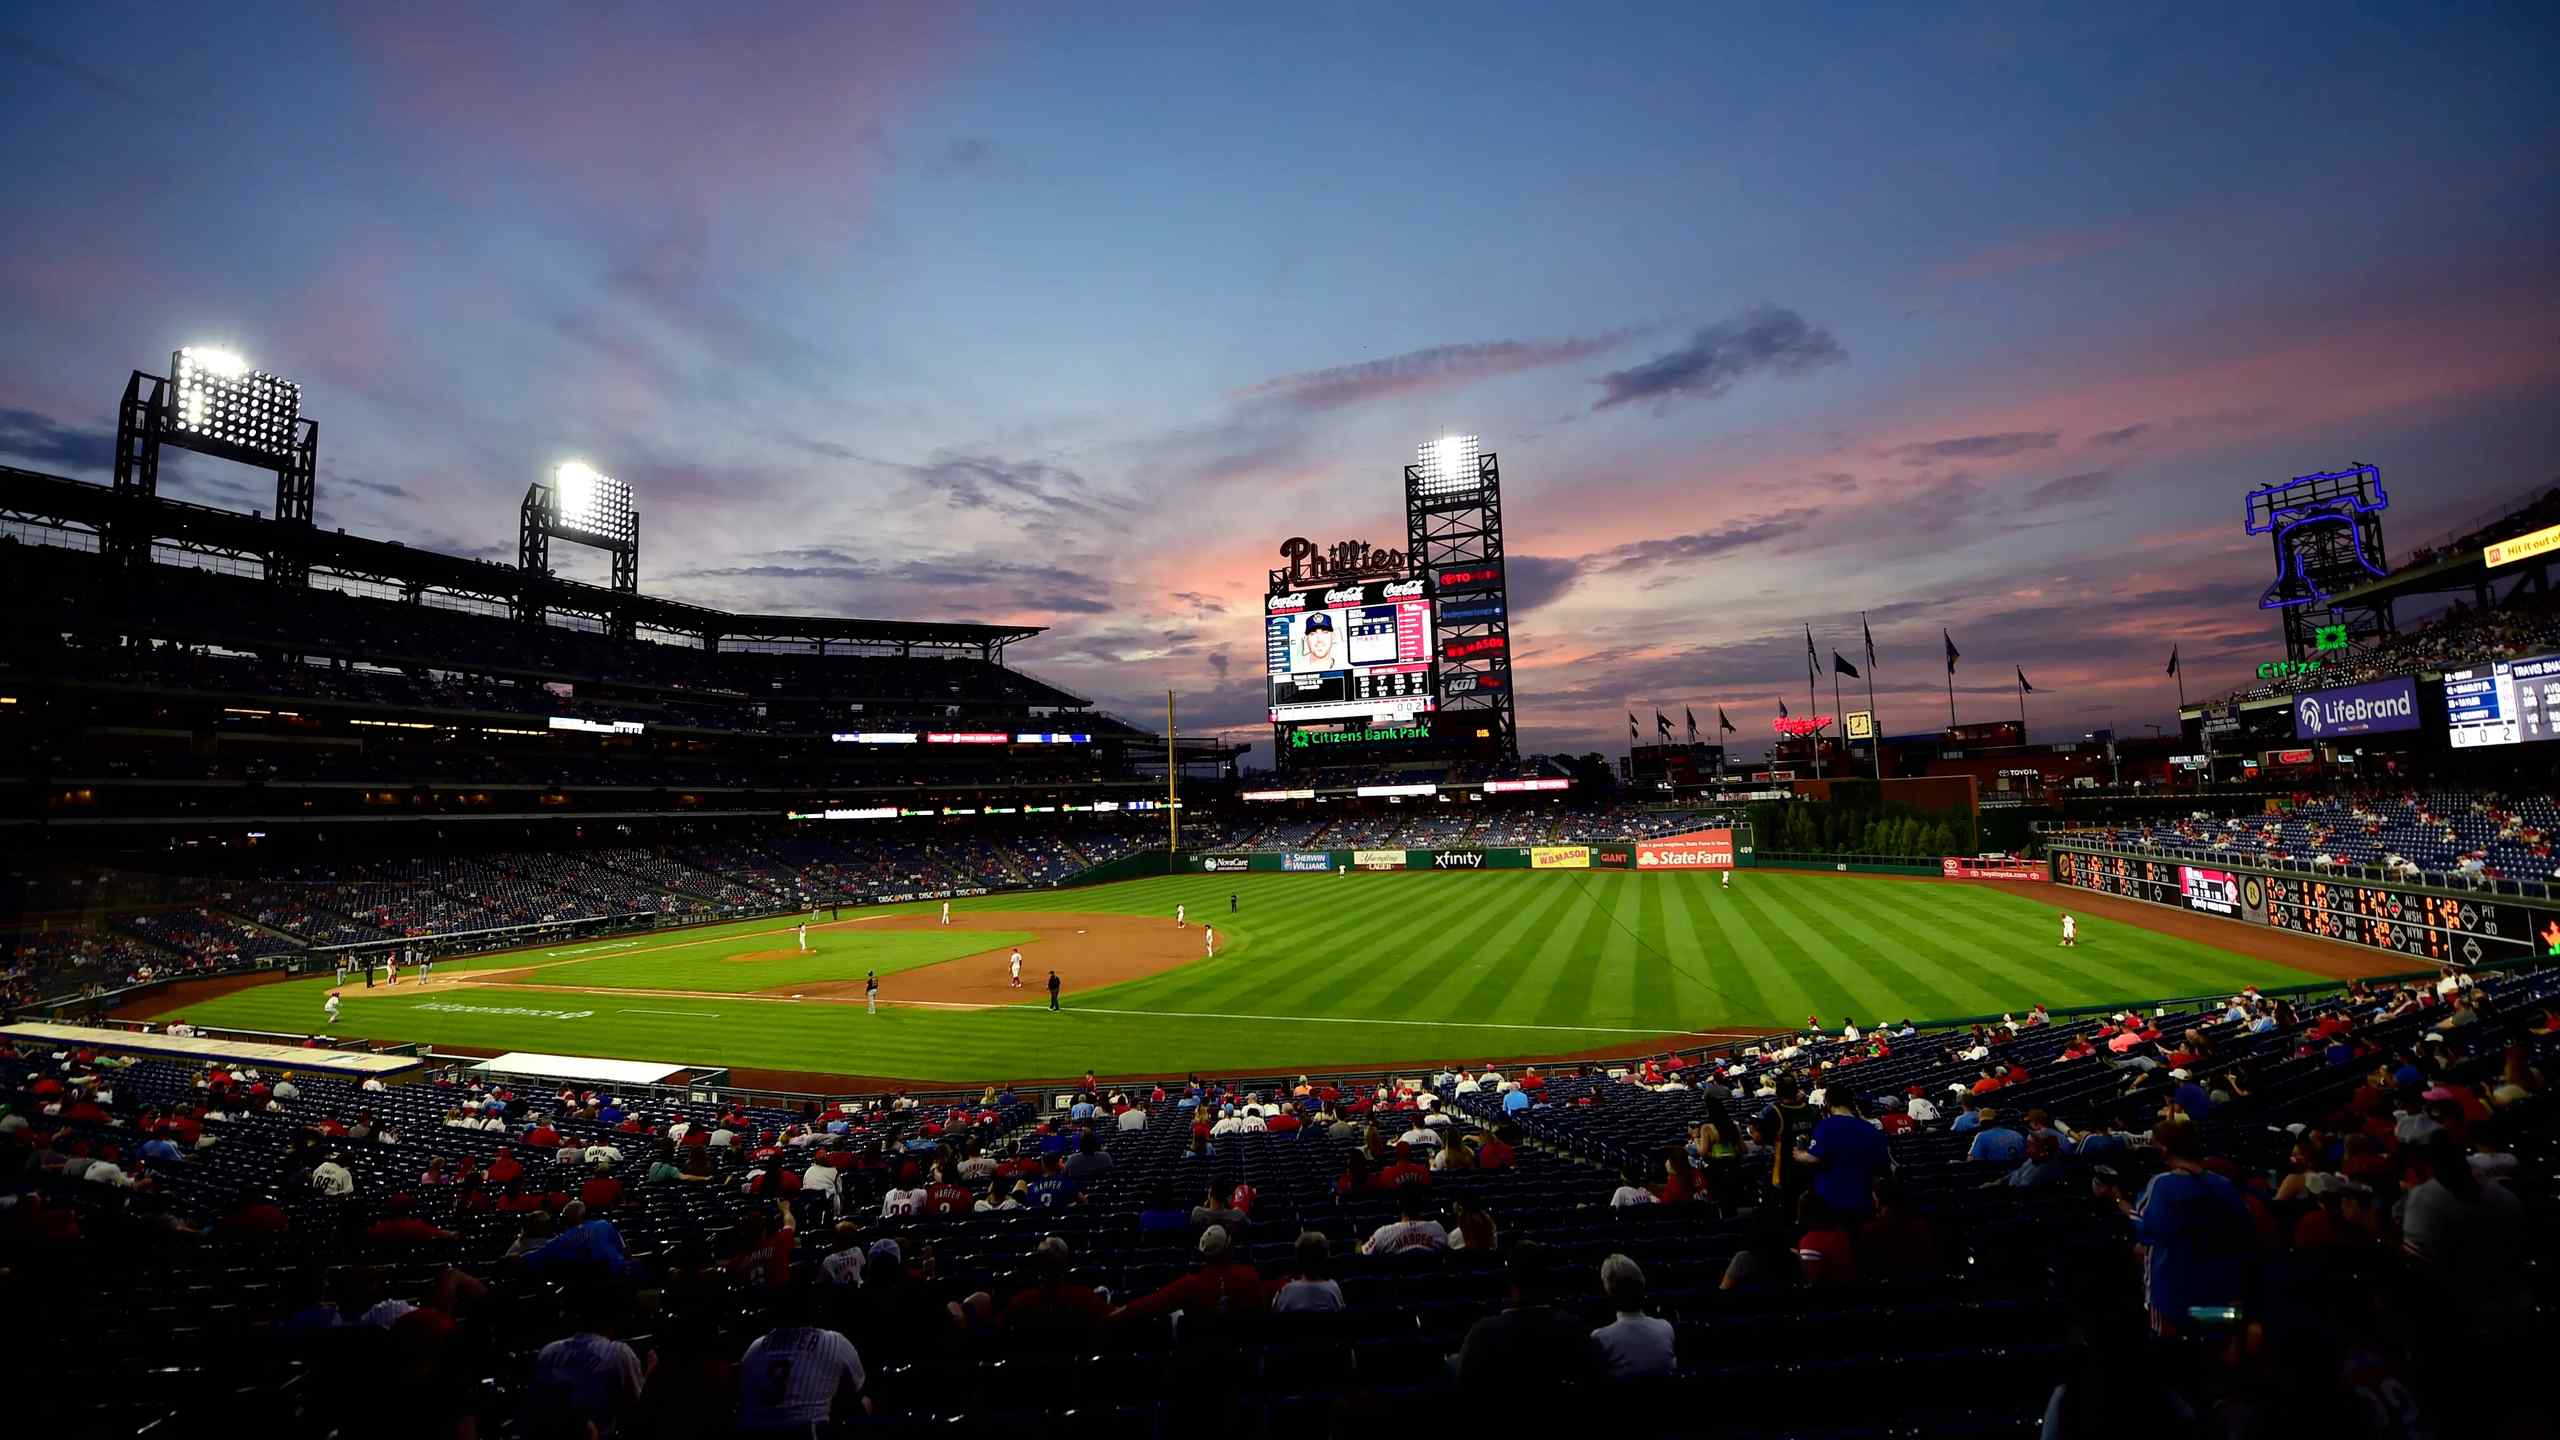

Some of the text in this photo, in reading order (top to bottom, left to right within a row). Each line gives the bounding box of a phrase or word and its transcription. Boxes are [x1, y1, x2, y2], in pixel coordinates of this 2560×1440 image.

[2507, 544, 2522, 556] Hit
[2524, 542, 2531, 551] it
[2533, 536, 2550, 548] out
[1280, 537, 1406, 584] Phillies
[1324, 586, 1365, 604] Coca-Cola
[1383, 580, 1424, 598] Coca-Cola
[1268, 593, 1307, 610] Coca-Cola
[2513, 664, 2542, 677] TRAVIS
[2325, 690, 2411, 724] LifeBrand
[1312, 726, 1429, 744] Citizens Bank Park
[2504, 727, 2511, 741] 2
[1294, 853, 1325, 862] SHERWIN
[1435, 851, 1482, 868] xfinity
[1600, 854, 1627, 863] GIANT
[2340, 886, 2354, 899] CWS
[2359, 888, 2365, 900] 0
[2343, 901, 2354, 912] CIN
[2405, 896, 2419, 908] ATL
[2426, 897, 2433, 910] 0
[2404, 910, 2422, 923] WSH
[2428, 912, 2435, 926] 0
[2482, 905, 2495, 919] PIT
[2407, 927, 2424, 940] NYM
[2430, 930, 2437, 943] 0
[2485, 921, 2497, 935] SD
[2410, 942, 2425, 955] STL
